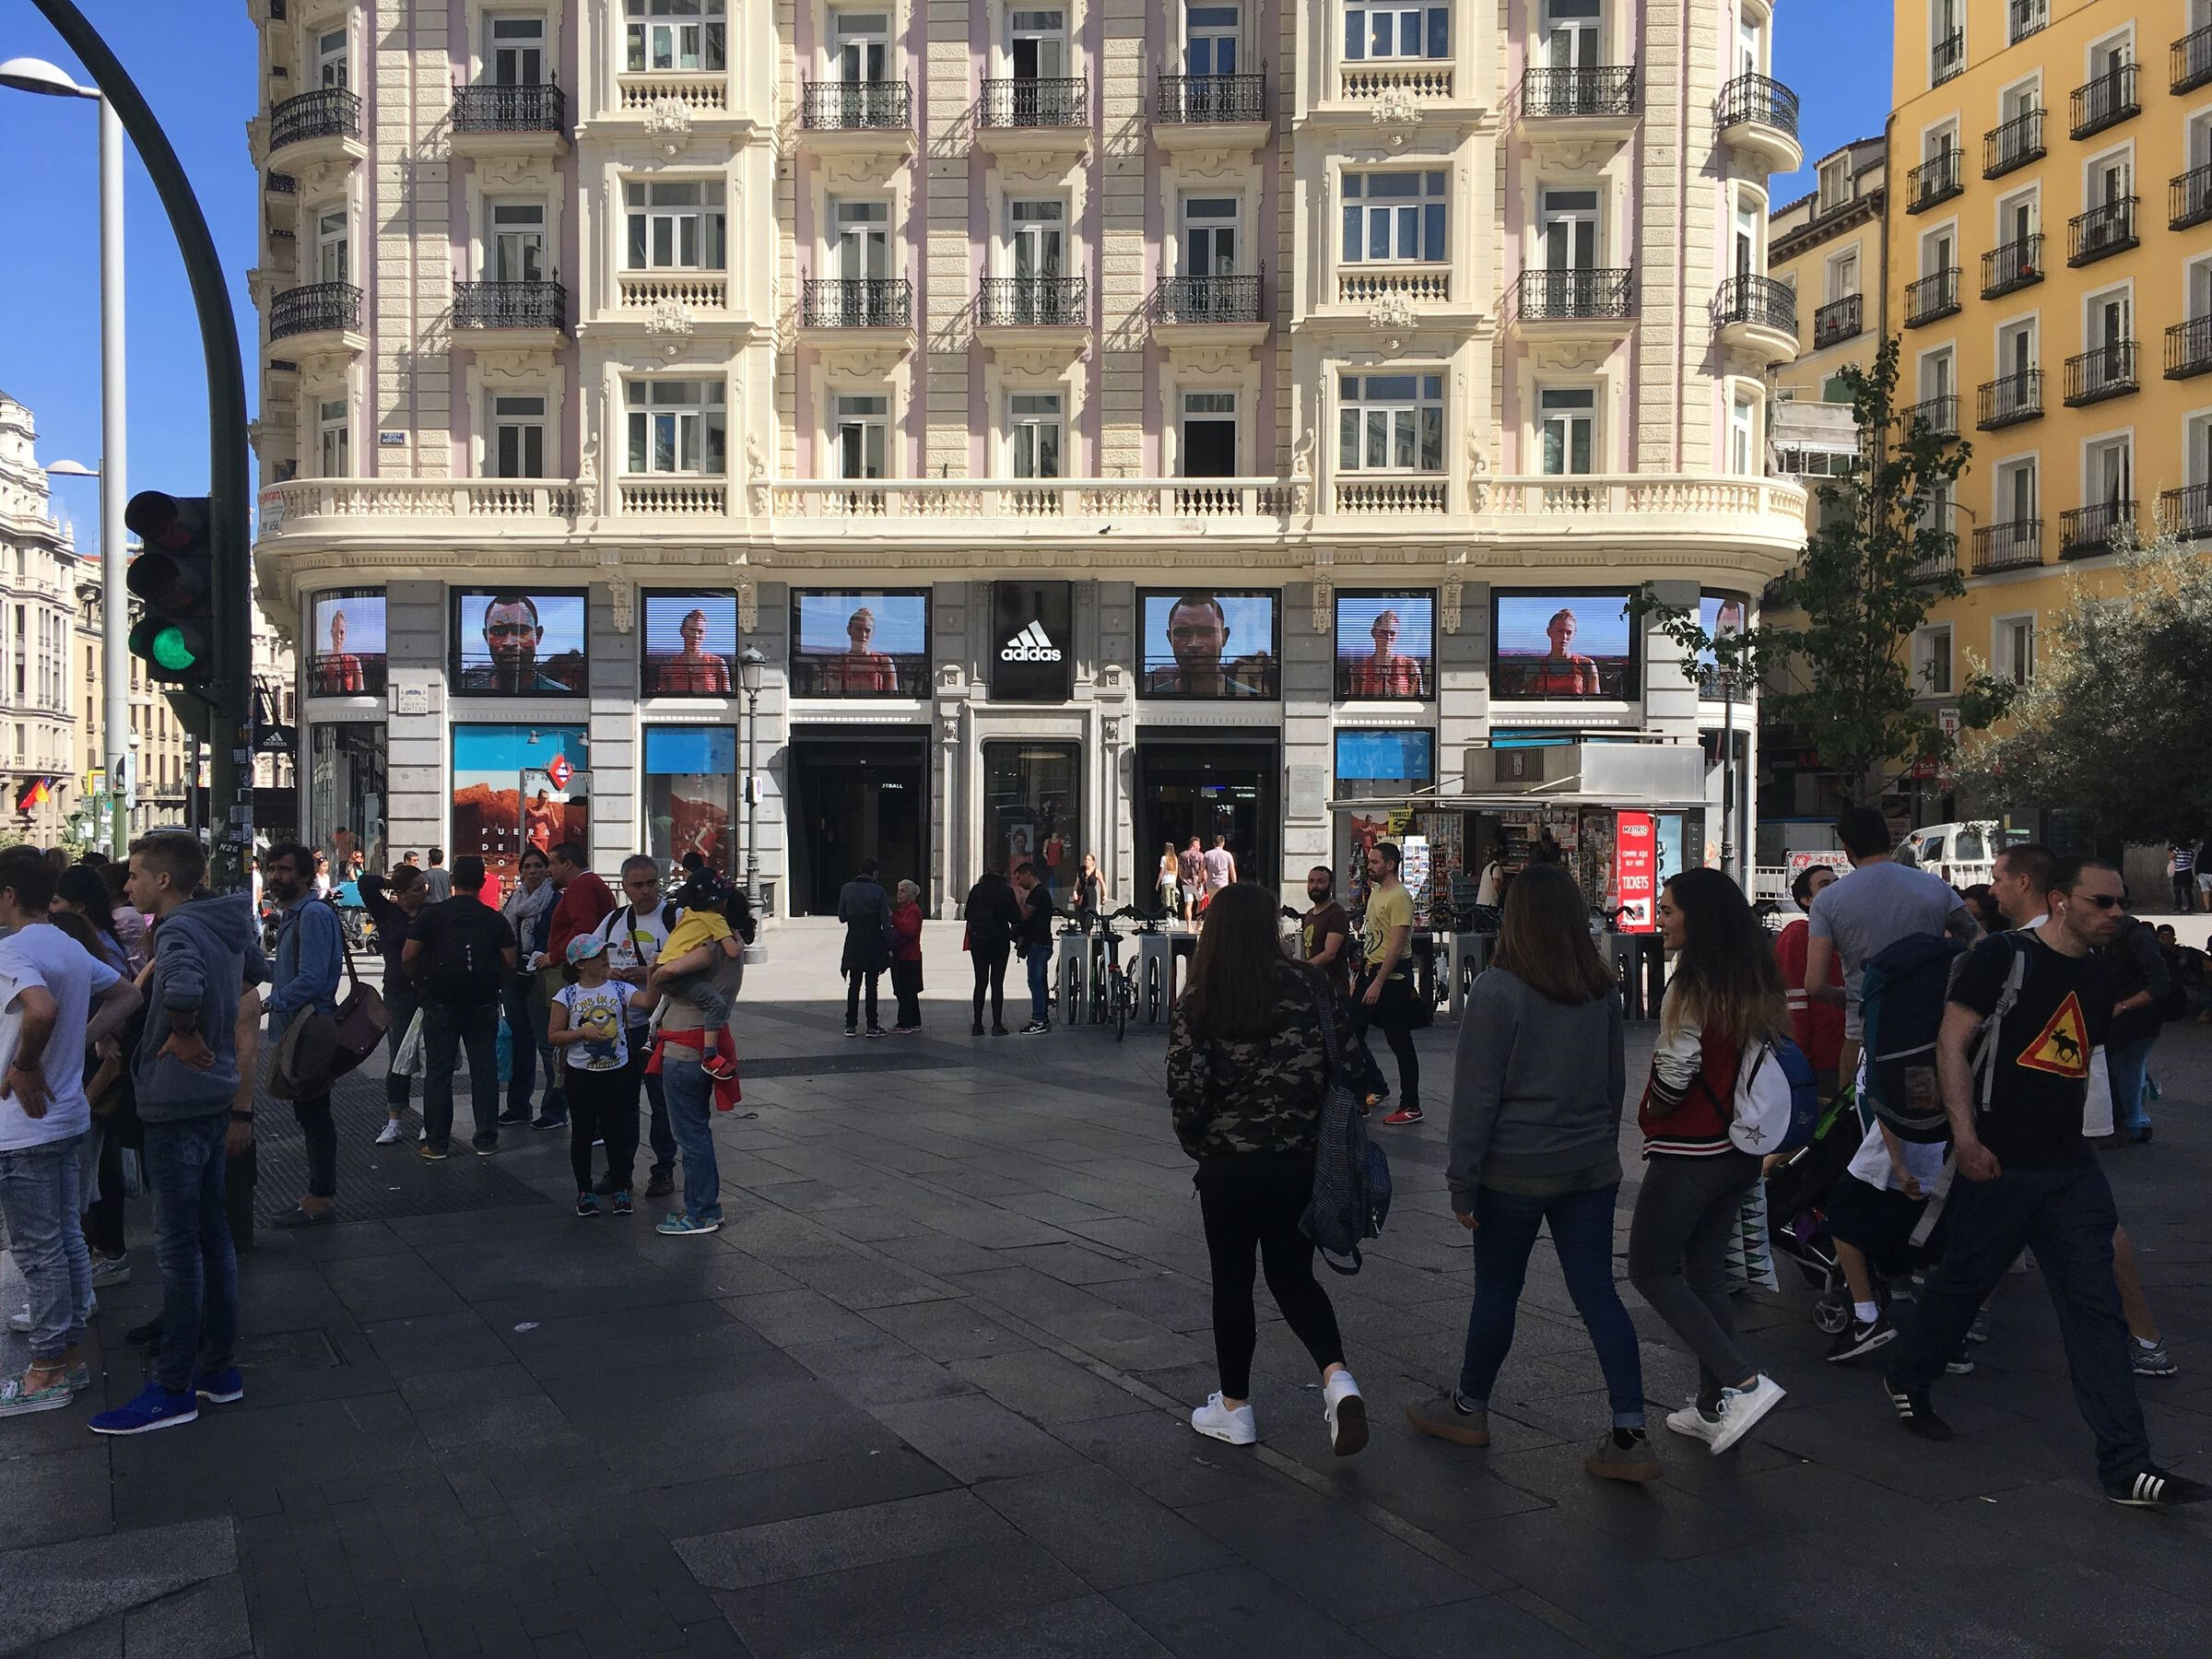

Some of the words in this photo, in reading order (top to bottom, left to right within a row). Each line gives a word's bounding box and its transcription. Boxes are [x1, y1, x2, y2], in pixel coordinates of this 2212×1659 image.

[1001, 646, 1062, 662] adidas
[219, 842, 240, 853] N26
[1622, 876, 1649, 889] TICKETS
